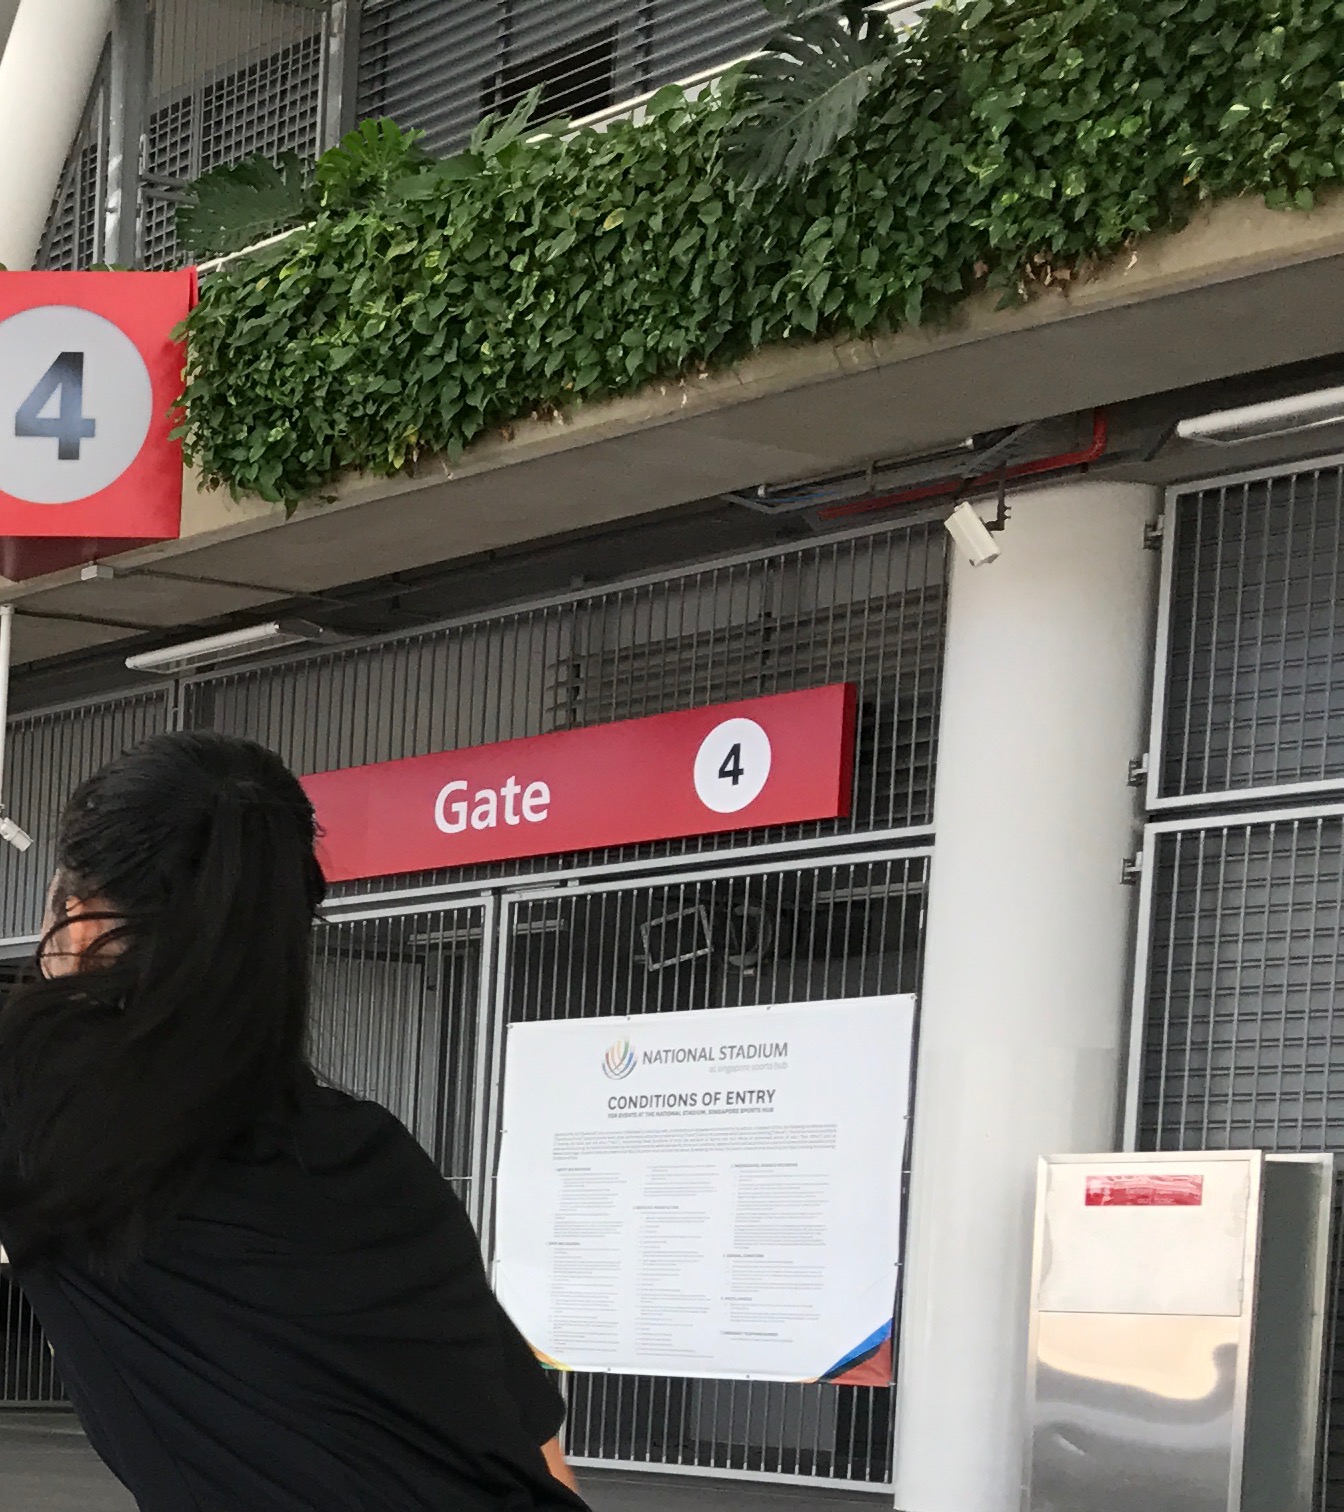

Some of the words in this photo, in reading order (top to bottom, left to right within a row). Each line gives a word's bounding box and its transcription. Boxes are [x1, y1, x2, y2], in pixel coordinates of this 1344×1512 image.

[15, 351, 96, 460] 4
[434, 775, 551, 834] Gate
[718, 743, 744, 786] 4
[642, 1046, 715, 1065] NATIONAL
[719, 1042, 788, 1061] STADIUM
[607, 1092, 698, 1110] CONDITIONS
[701, 1091, 722, 1107] OF
[726, 1089, 776, 1105] ENTRY
